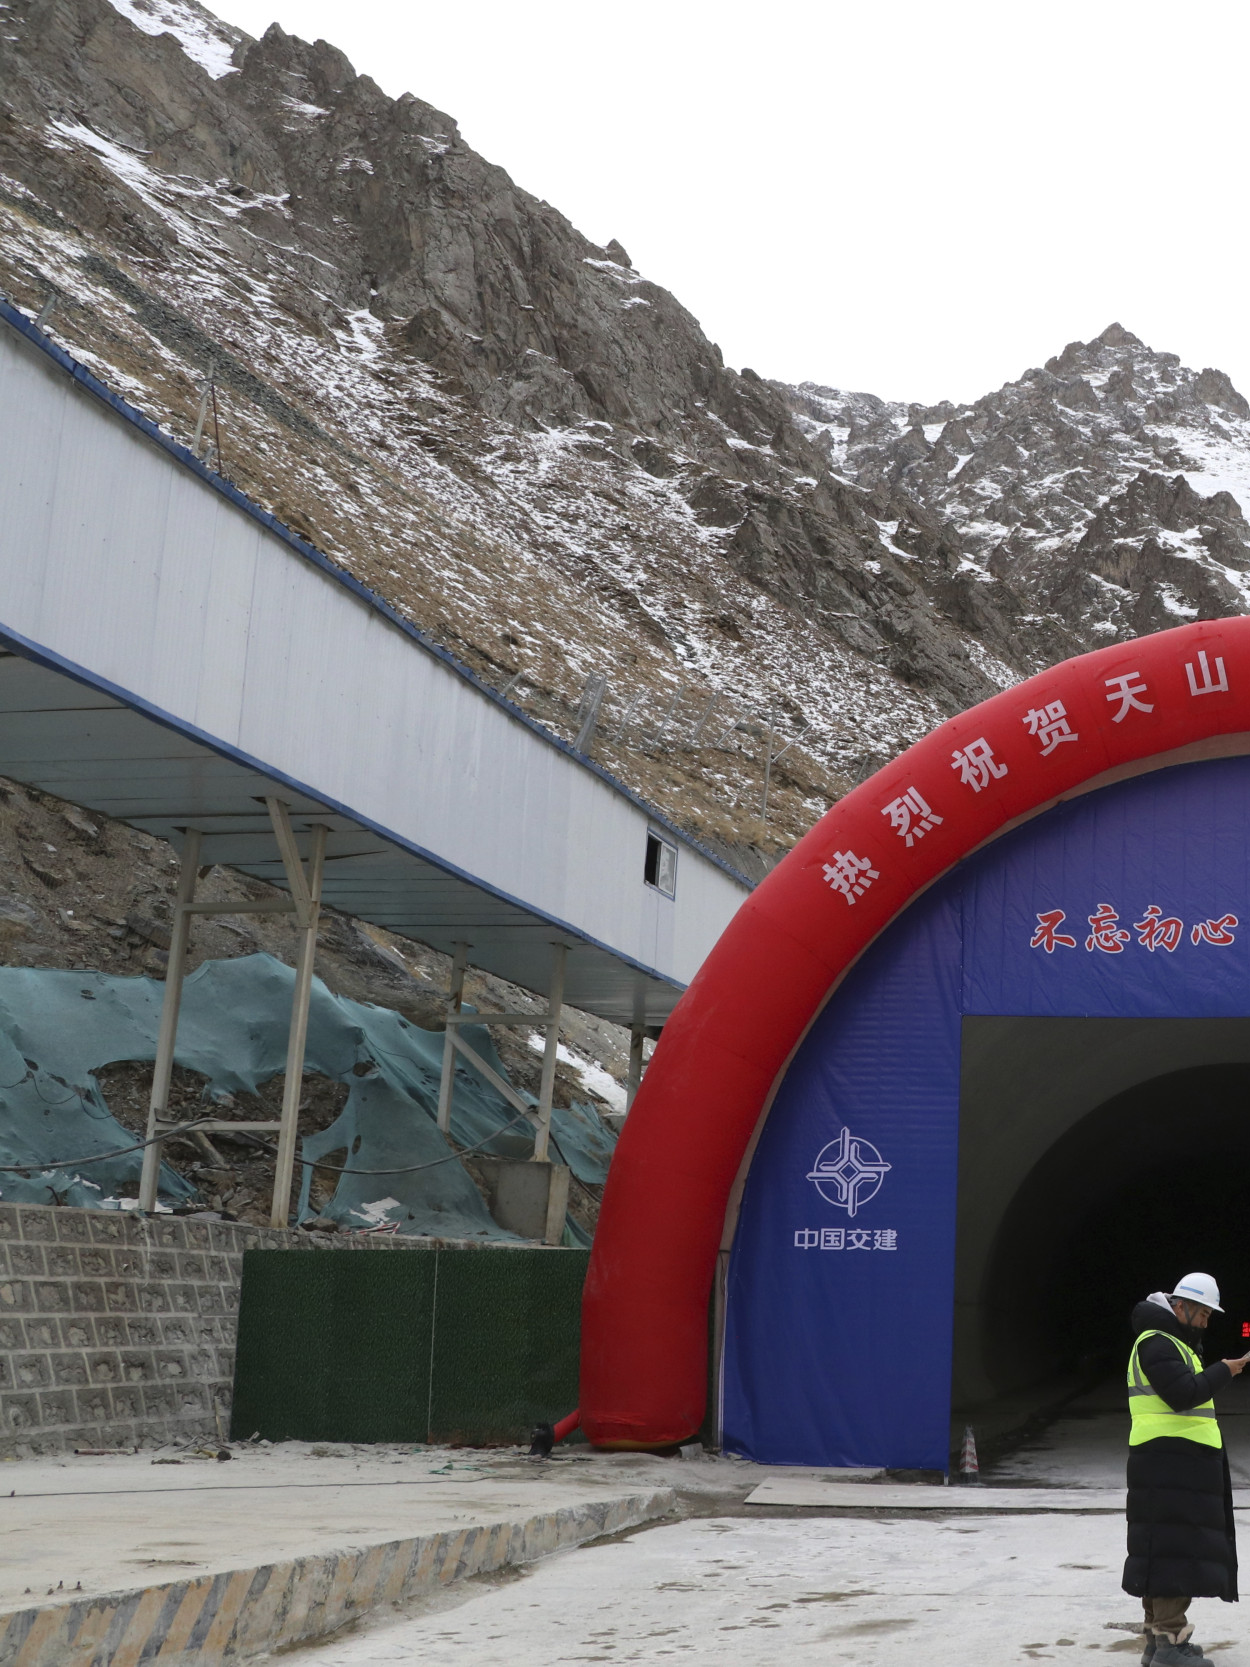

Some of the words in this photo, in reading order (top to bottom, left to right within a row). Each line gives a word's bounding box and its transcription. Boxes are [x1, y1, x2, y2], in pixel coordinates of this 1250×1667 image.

[1030, 904, 1238, 953] 不忘初心
[794, 1228, 898, 1250] 中国交建
